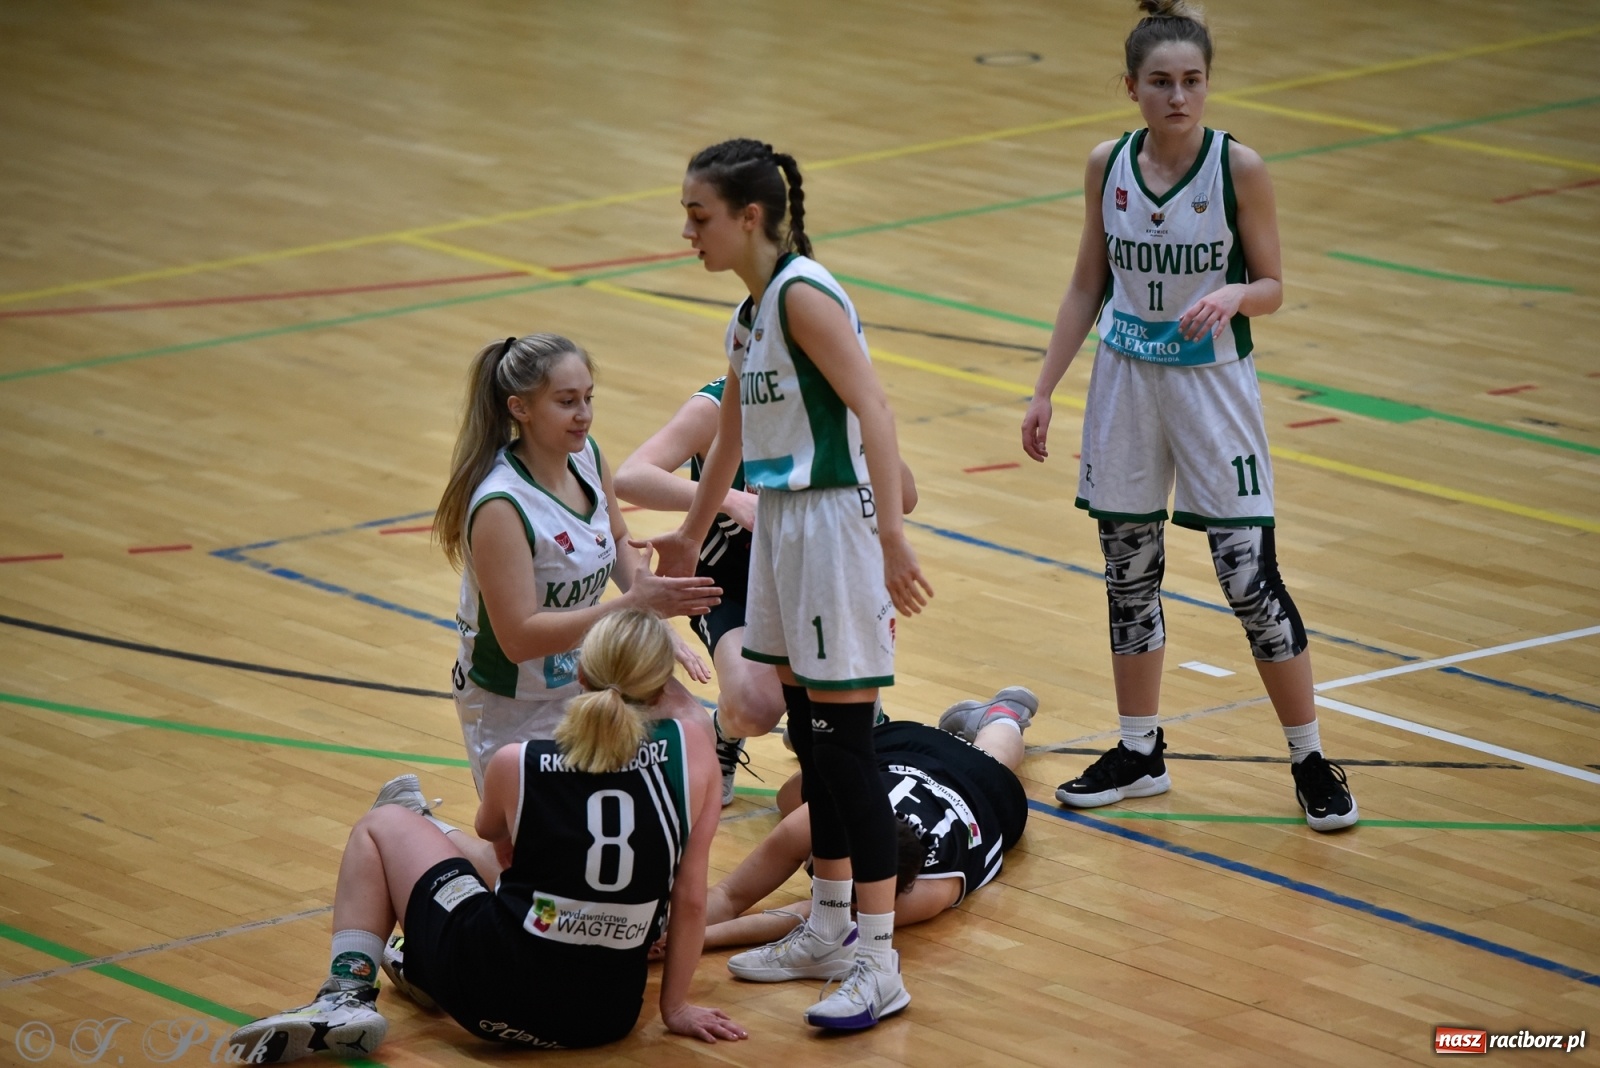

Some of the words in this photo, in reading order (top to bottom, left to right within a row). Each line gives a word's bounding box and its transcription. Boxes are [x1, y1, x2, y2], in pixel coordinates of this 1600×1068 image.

[1105, 232, 1225, 275] KATOWICE
[1147, 281, 1164, 311] 11
[1231, 454, 1261, 496] 11
[812, 615, 827, 660] 1
[585, 789, 635, 892] 8
[557, 917, 648, 940] WAGTECH
[559, 909, 628, 924] wydawnictwo
